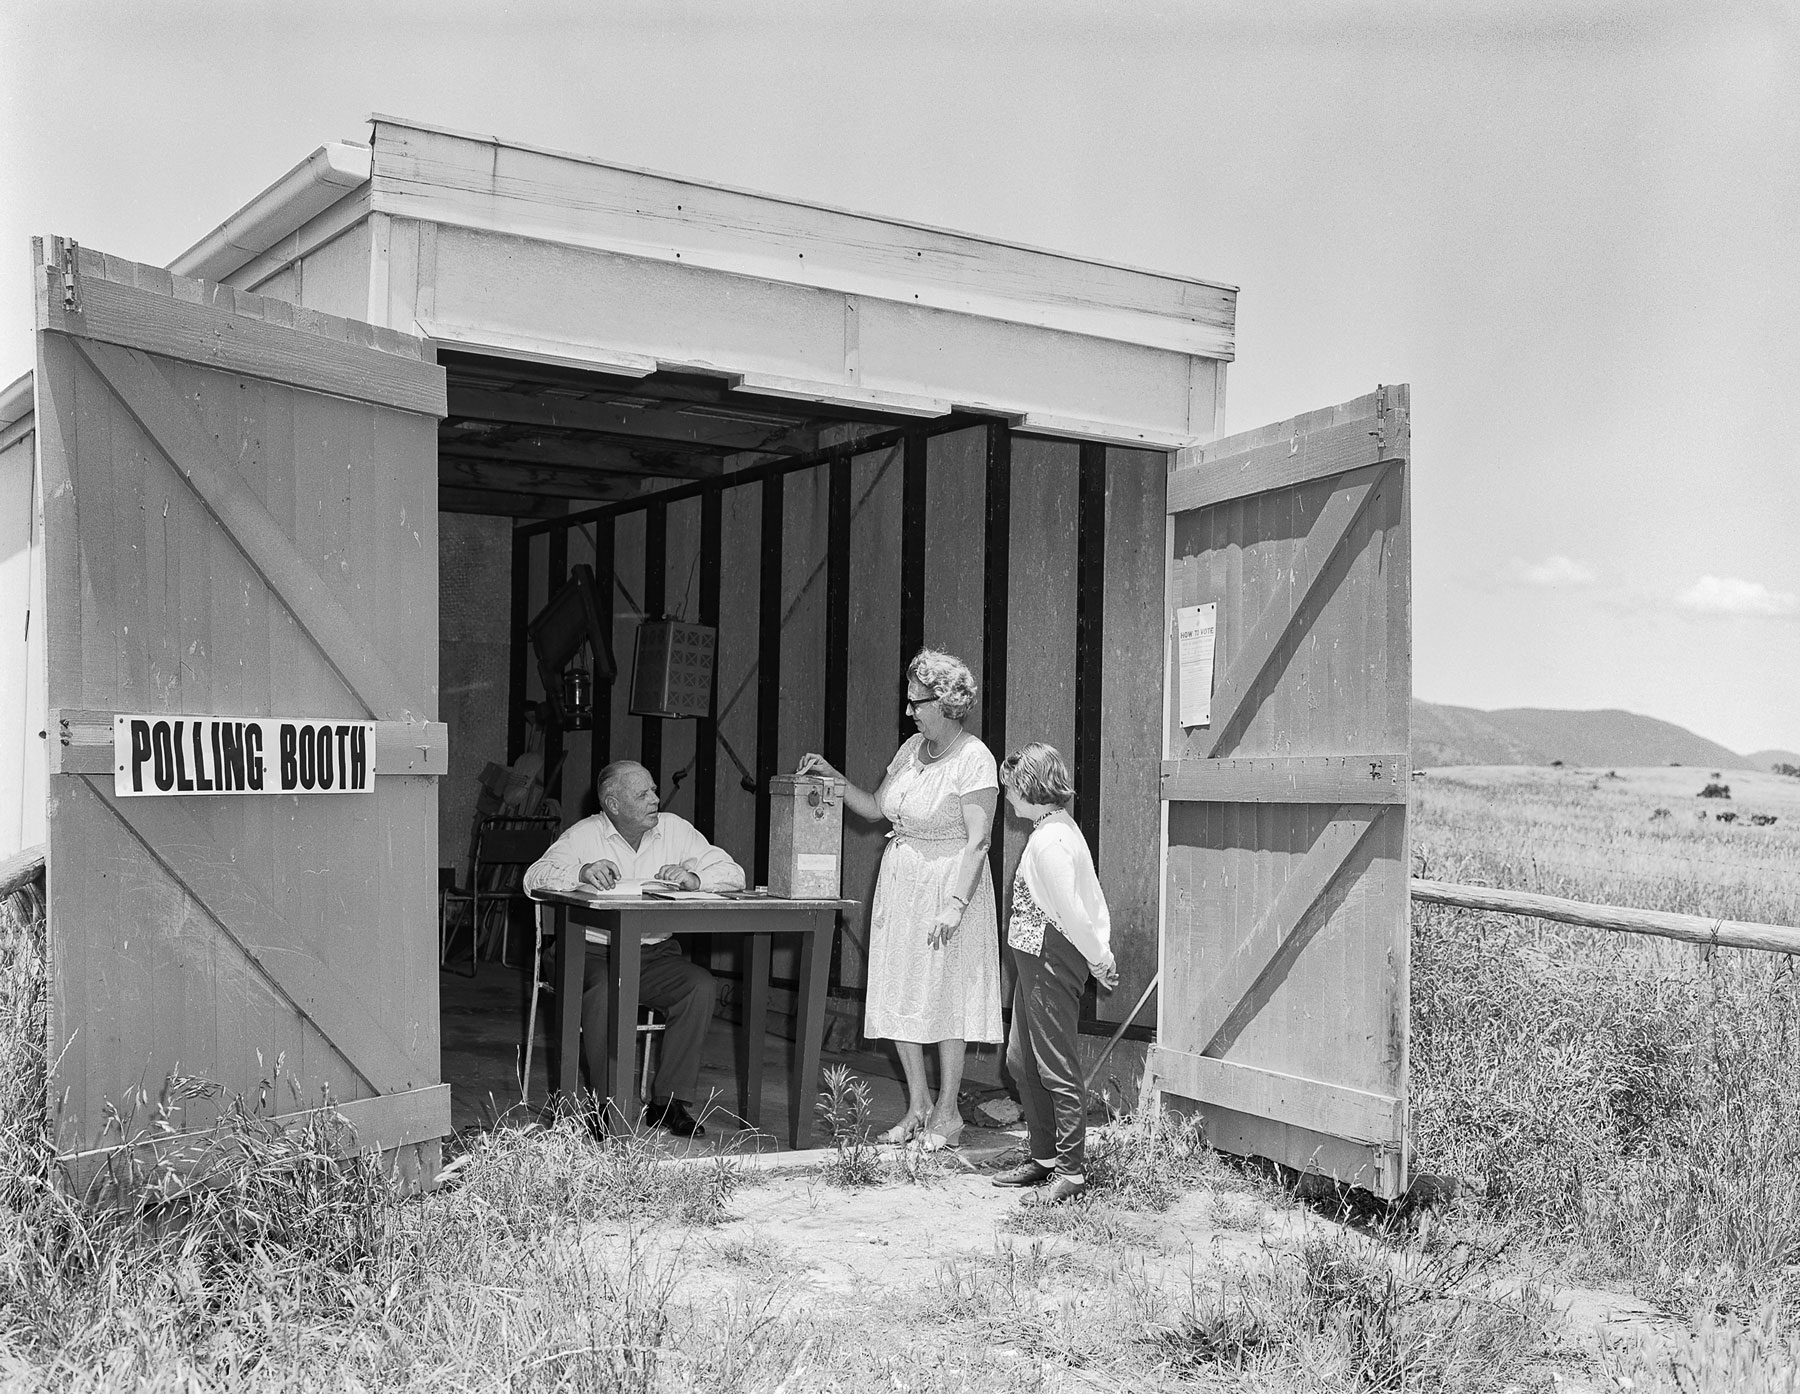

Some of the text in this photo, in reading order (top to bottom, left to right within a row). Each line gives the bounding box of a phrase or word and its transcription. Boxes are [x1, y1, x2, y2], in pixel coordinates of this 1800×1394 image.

[1180, 631, 1193, 639] HOW
[1200, 627, 1214, 635] VOTE
[131, 720, 365, 792] POLLING BOOTH
